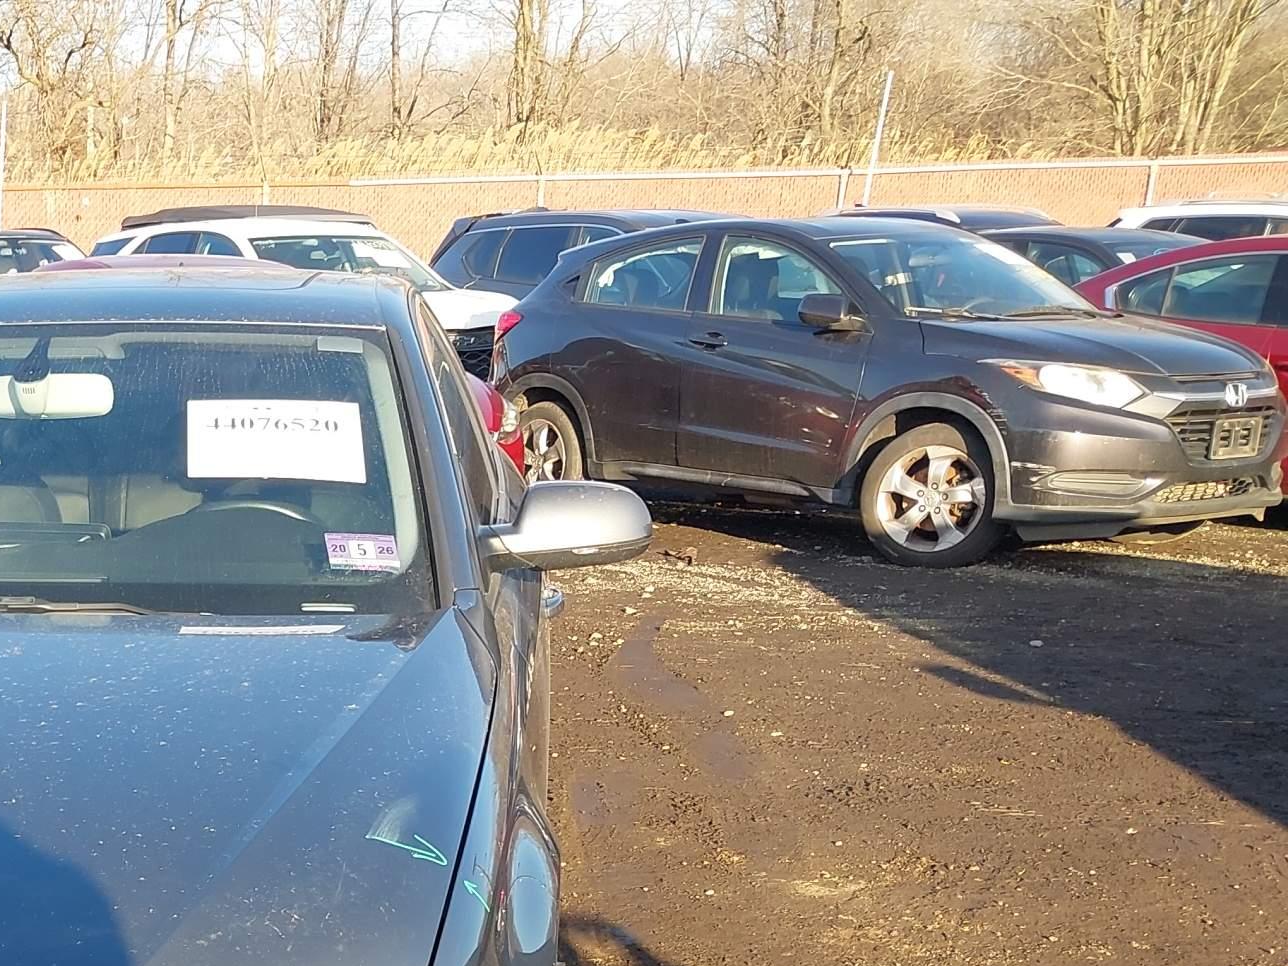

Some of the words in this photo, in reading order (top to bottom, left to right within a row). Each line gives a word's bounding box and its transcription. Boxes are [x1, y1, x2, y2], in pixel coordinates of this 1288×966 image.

[206, 417, 339, 432] 44076520
[331, 544, 346, 553] 20
[357, 543, 367, 556] 5
[377, 546, 394, 555] 26
